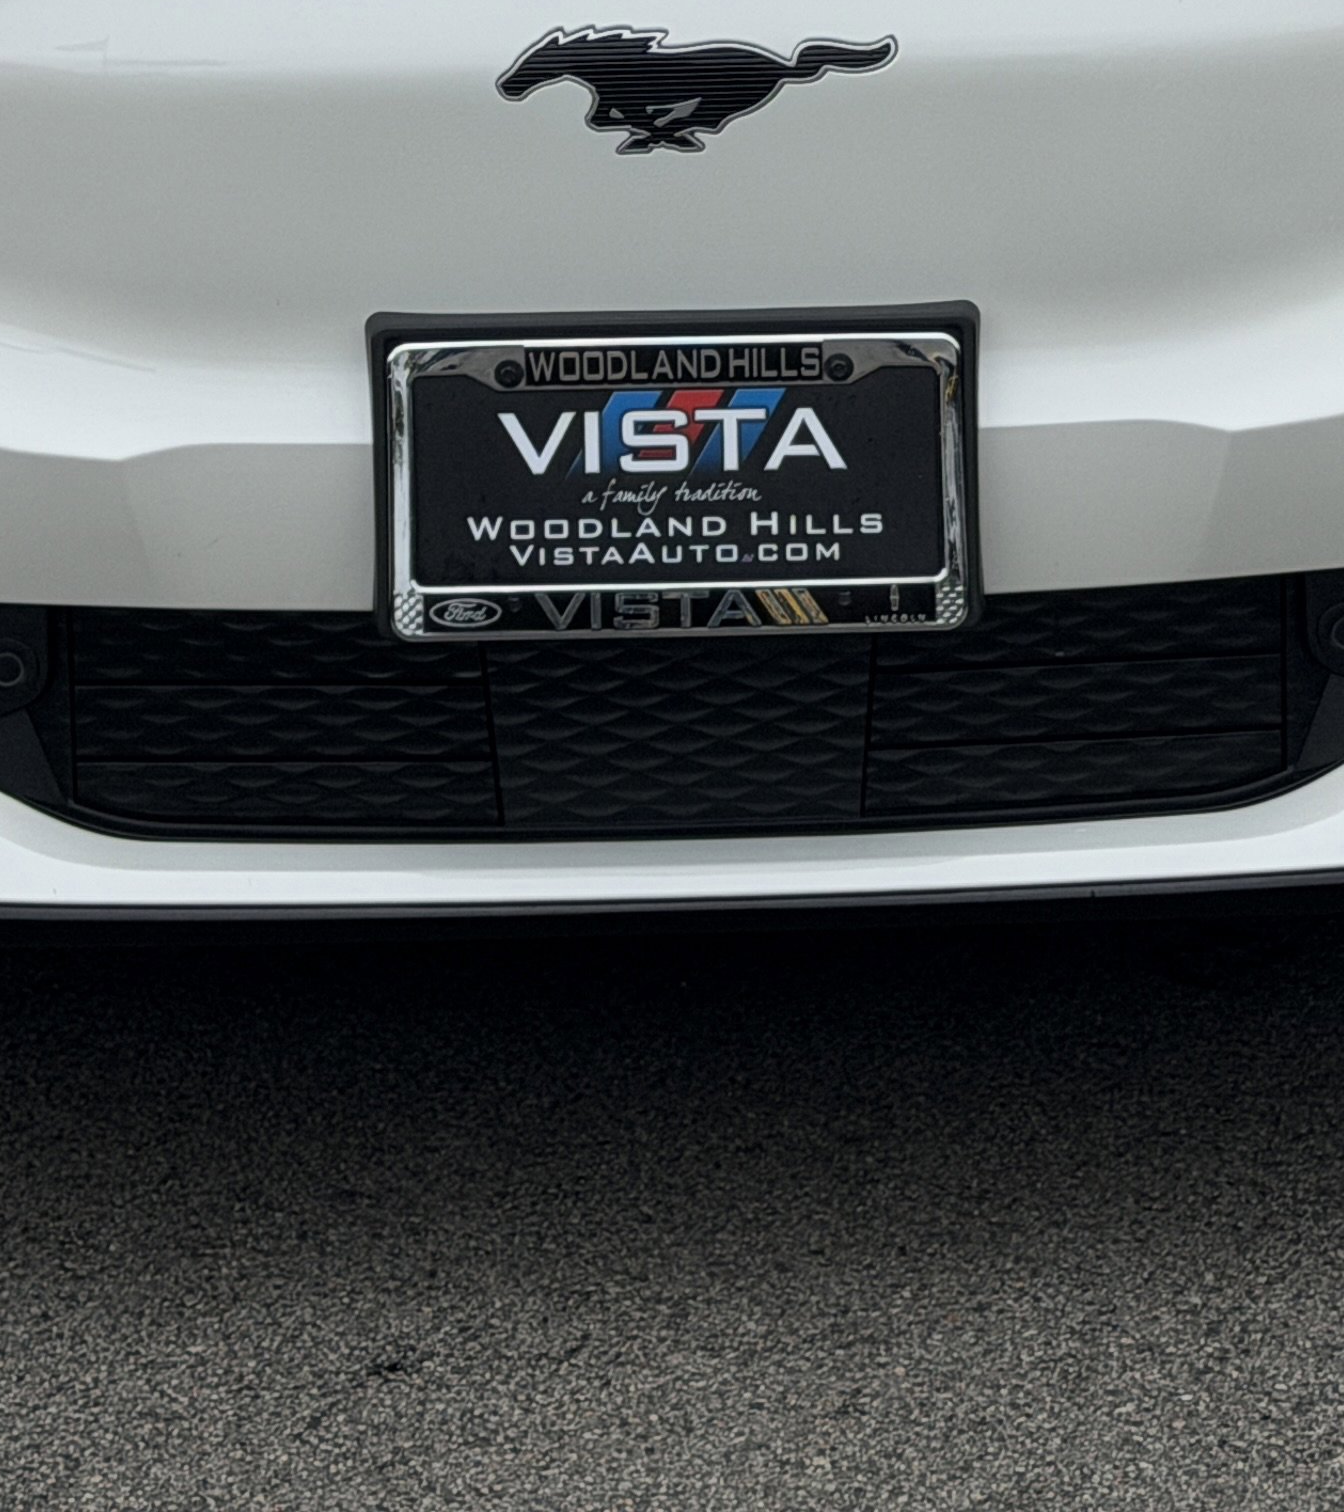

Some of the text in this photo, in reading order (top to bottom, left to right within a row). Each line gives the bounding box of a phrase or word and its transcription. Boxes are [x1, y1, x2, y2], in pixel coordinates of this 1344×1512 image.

[528, 346, 821, 382] WOODLAND HILLS
[498, 406, 848, 475] VISTA
[581, 477, 762, 515] a family tradition
[467, 511, 884, 542] WOODLAND HILLS
[443, 602, 488, 622] Ford
[533, 589, 762, 631] VISTA
[864, 612, 927, 625] LINCOLN
